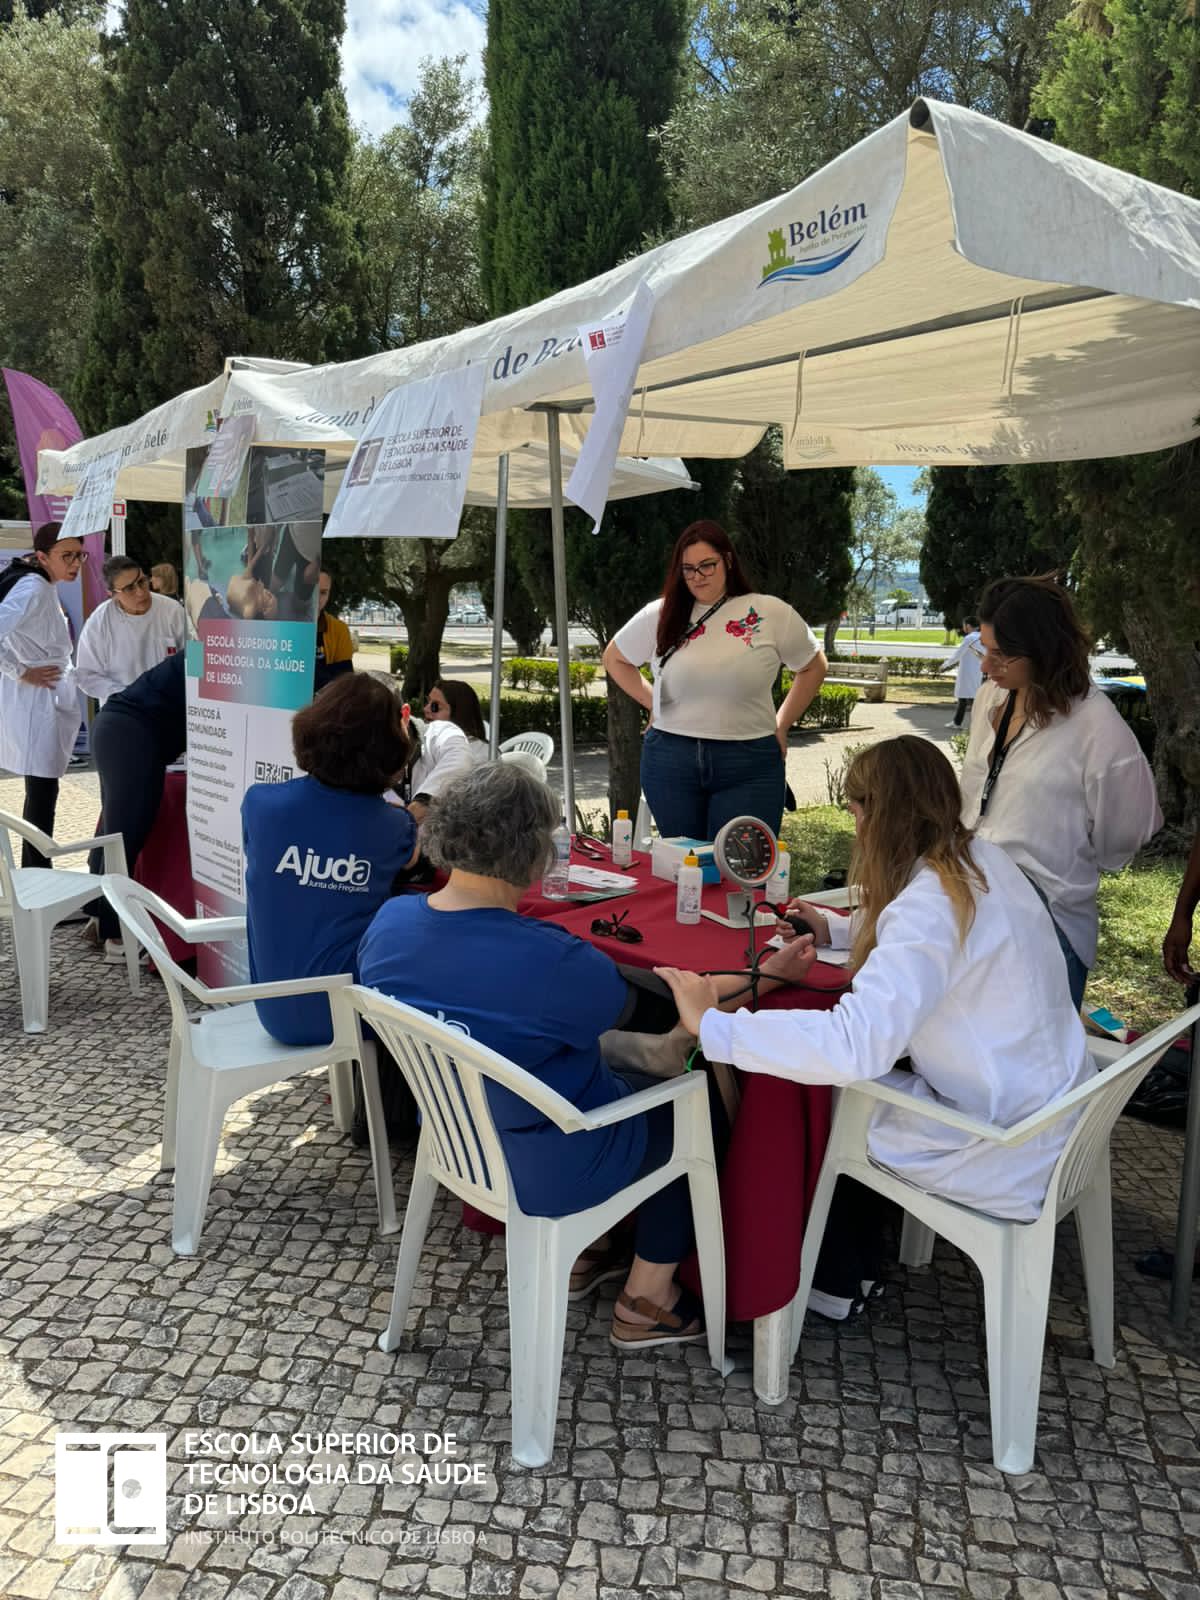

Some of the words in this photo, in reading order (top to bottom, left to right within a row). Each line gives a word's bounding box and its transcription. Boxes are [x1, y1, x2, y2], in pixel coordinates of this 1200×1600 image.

[788, 202, 868, 247] Belém
[493, 345, 529, 380] de
[450, 425, 463, 437] DE
[207, 635, 235, 649] ESCOLA
[237, 637, 278, 651] SUPERIOR
[280, 640, 293, 652] DE
[207, 653, 254, 669] TECNOLOGIA
[258, 657, 272, 669] DA
[274, 656, 305, 673] SAÚDE
[206, 671, 216, 683] DE
[217, 672, 243, 686] LISBOA
[275, 845, 371, 886] Ajuda
[307, 880, 327, 889] Junta
[327, 882, 338, 890] de
